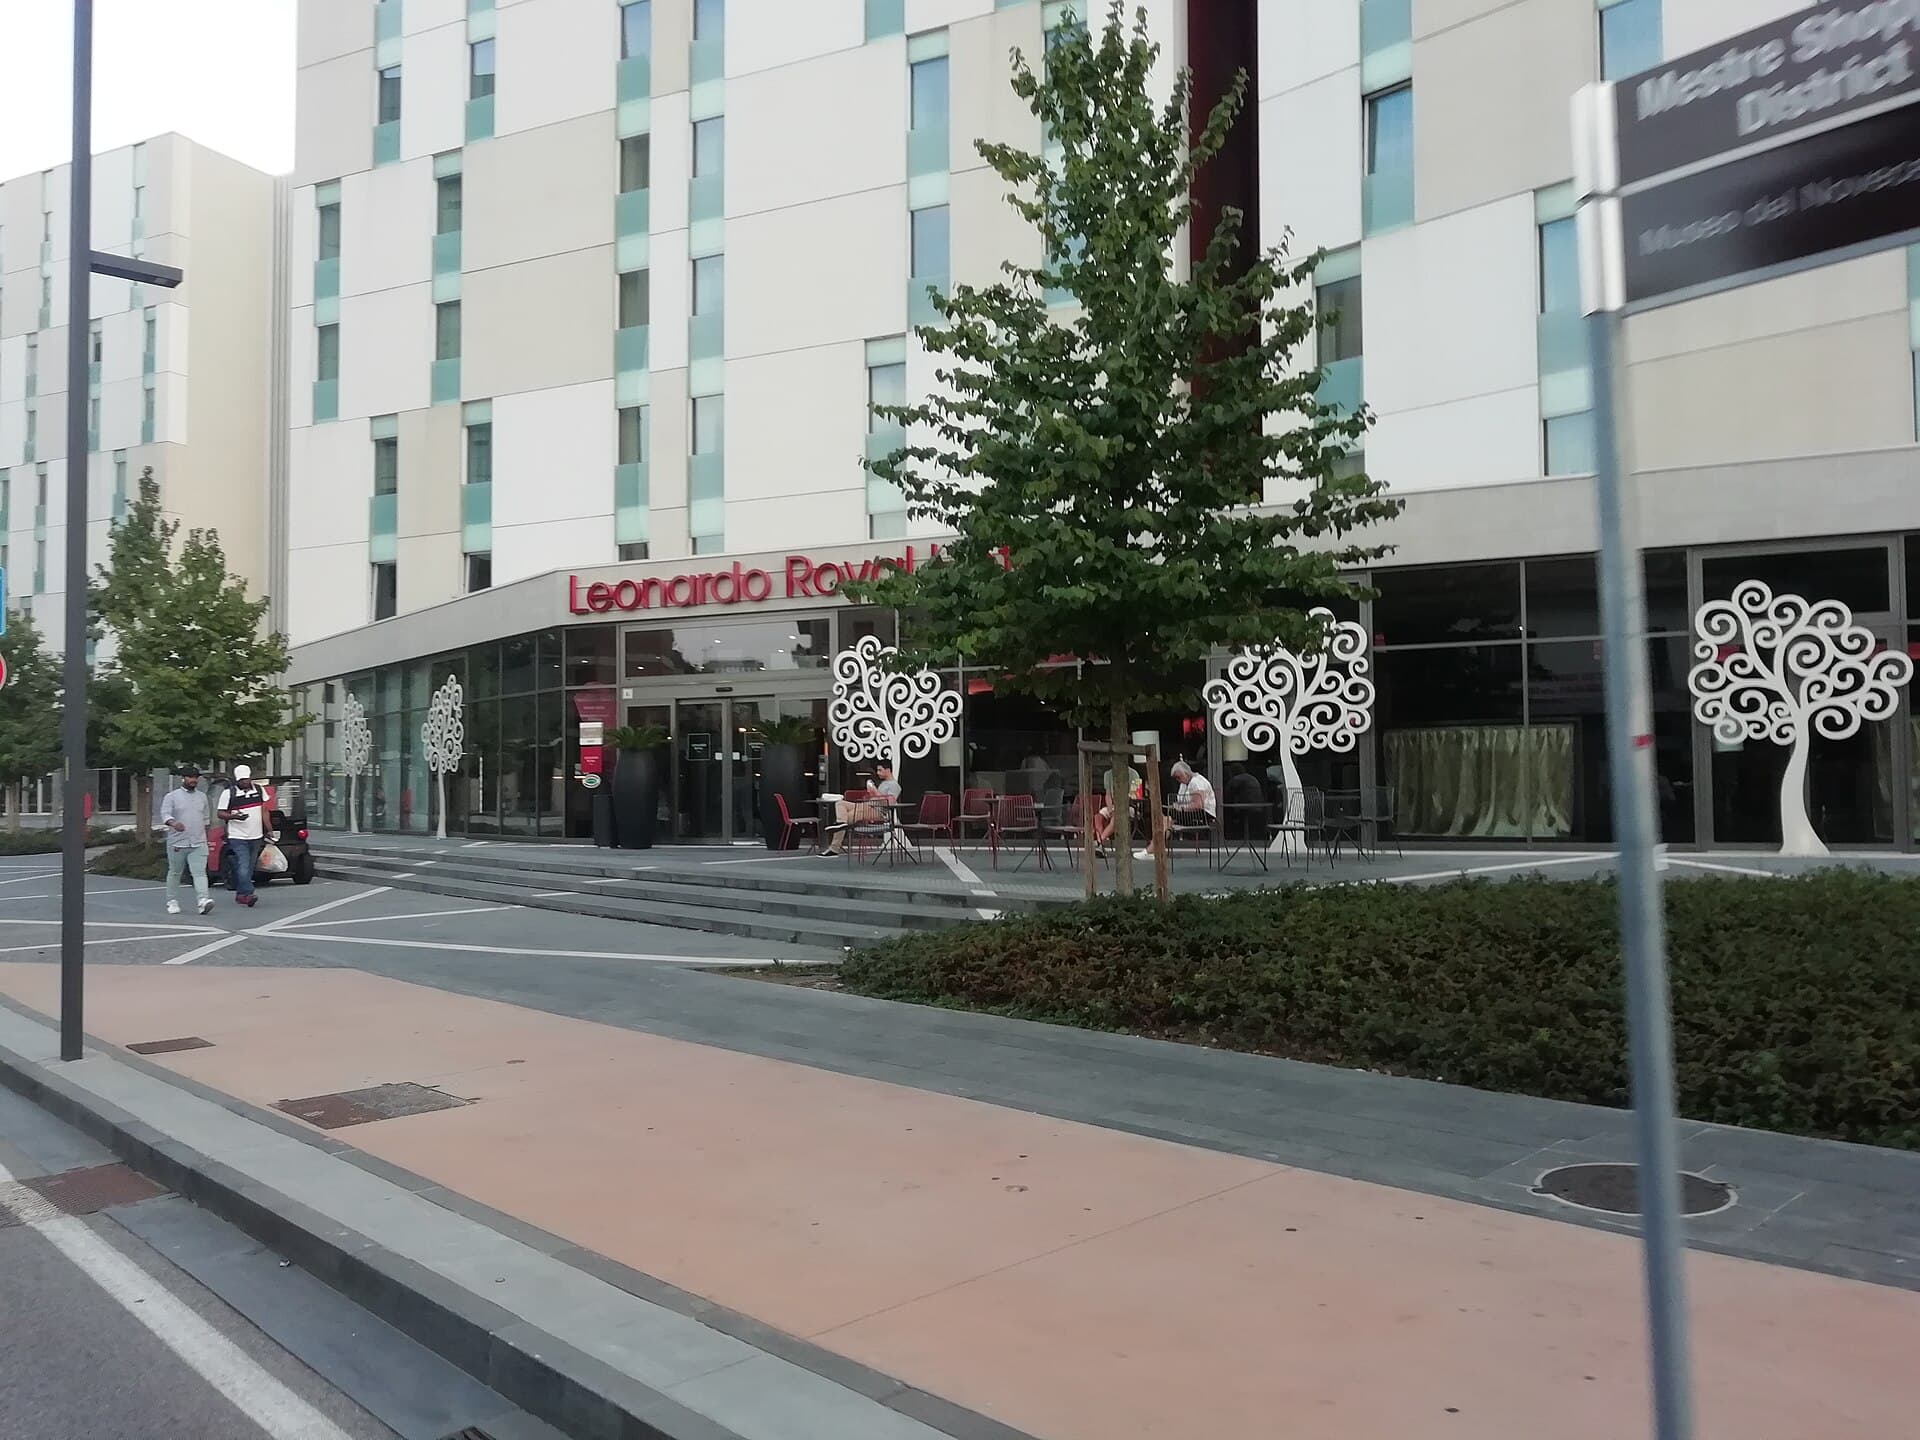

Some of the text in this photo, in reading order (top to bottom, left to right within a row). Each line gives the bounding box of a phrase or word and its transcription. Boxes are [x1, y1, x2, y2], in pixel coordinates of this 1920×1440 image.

[1637, 0, 1920, 121] Mestre Shop
[1736, 40, 1913, 136] District
[569, 561, 772, 615] Leonardo
